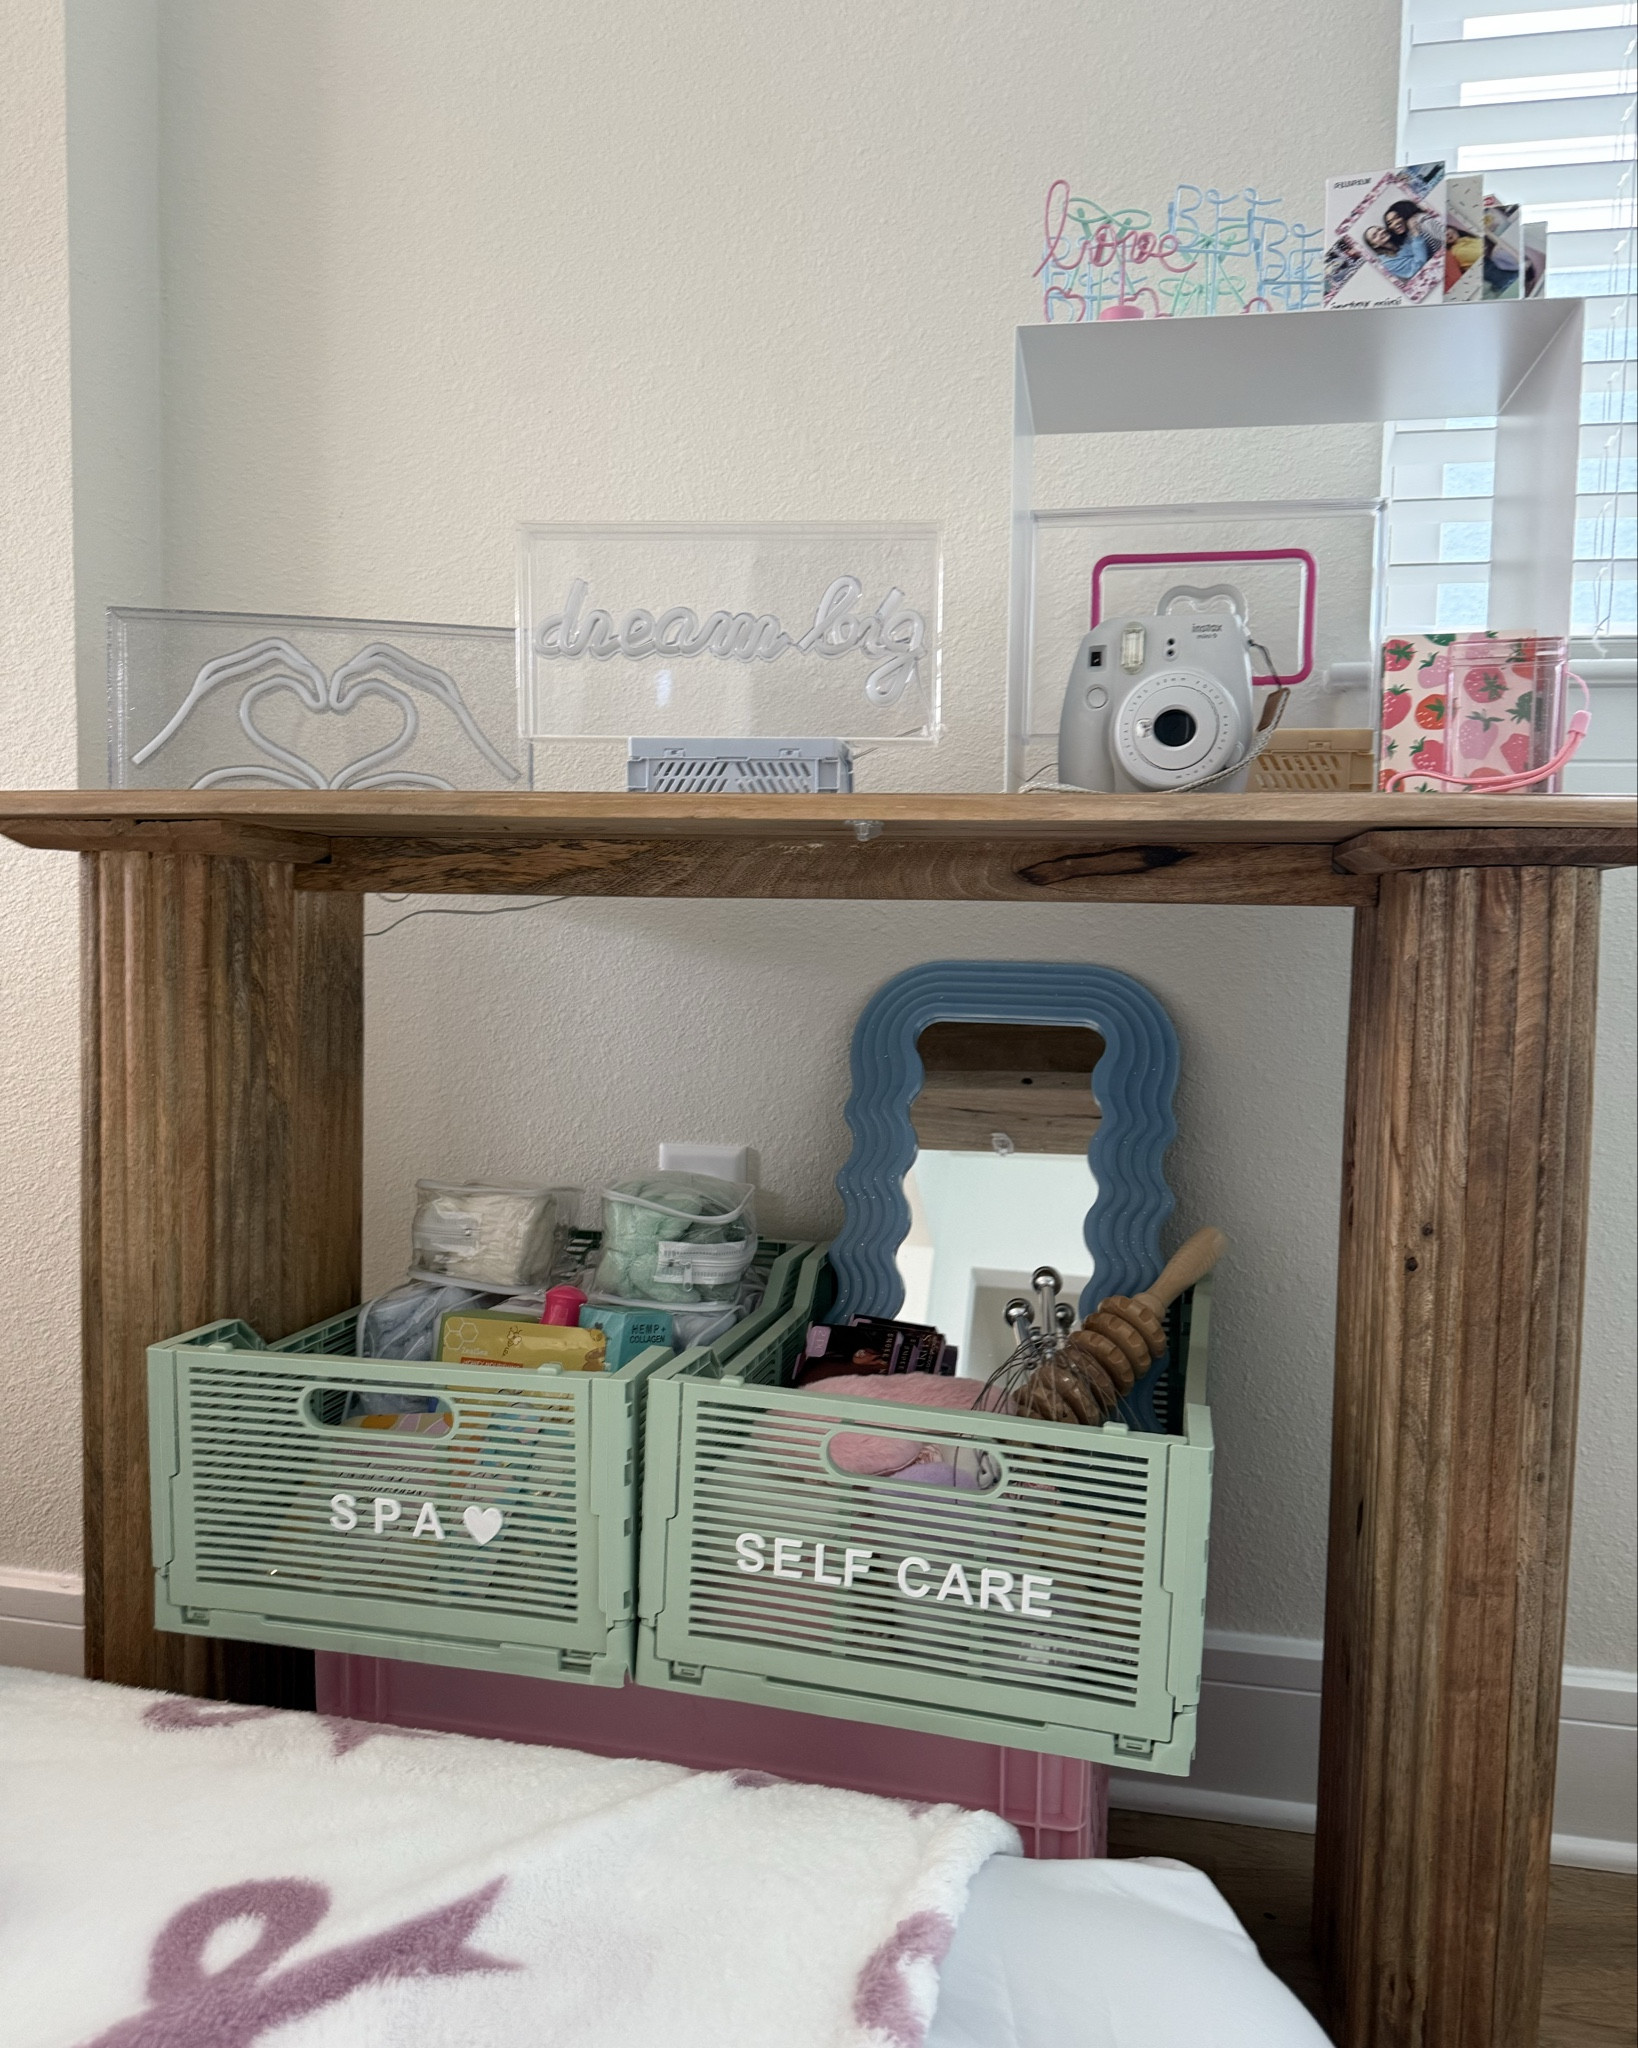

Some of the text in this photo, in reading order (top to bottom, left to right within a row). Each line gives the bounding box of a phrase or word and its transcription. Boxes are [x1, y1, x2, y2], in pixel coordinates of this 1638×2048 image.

[1032, 180, 1198, 278] love
[535, 575, 927, 707] dream big
[629, 1335, 665, 1343] COLLAGEN
[330, 1493, 445, 1540] SPA
[735, 1532, 1055, 1618] SELF CARE
